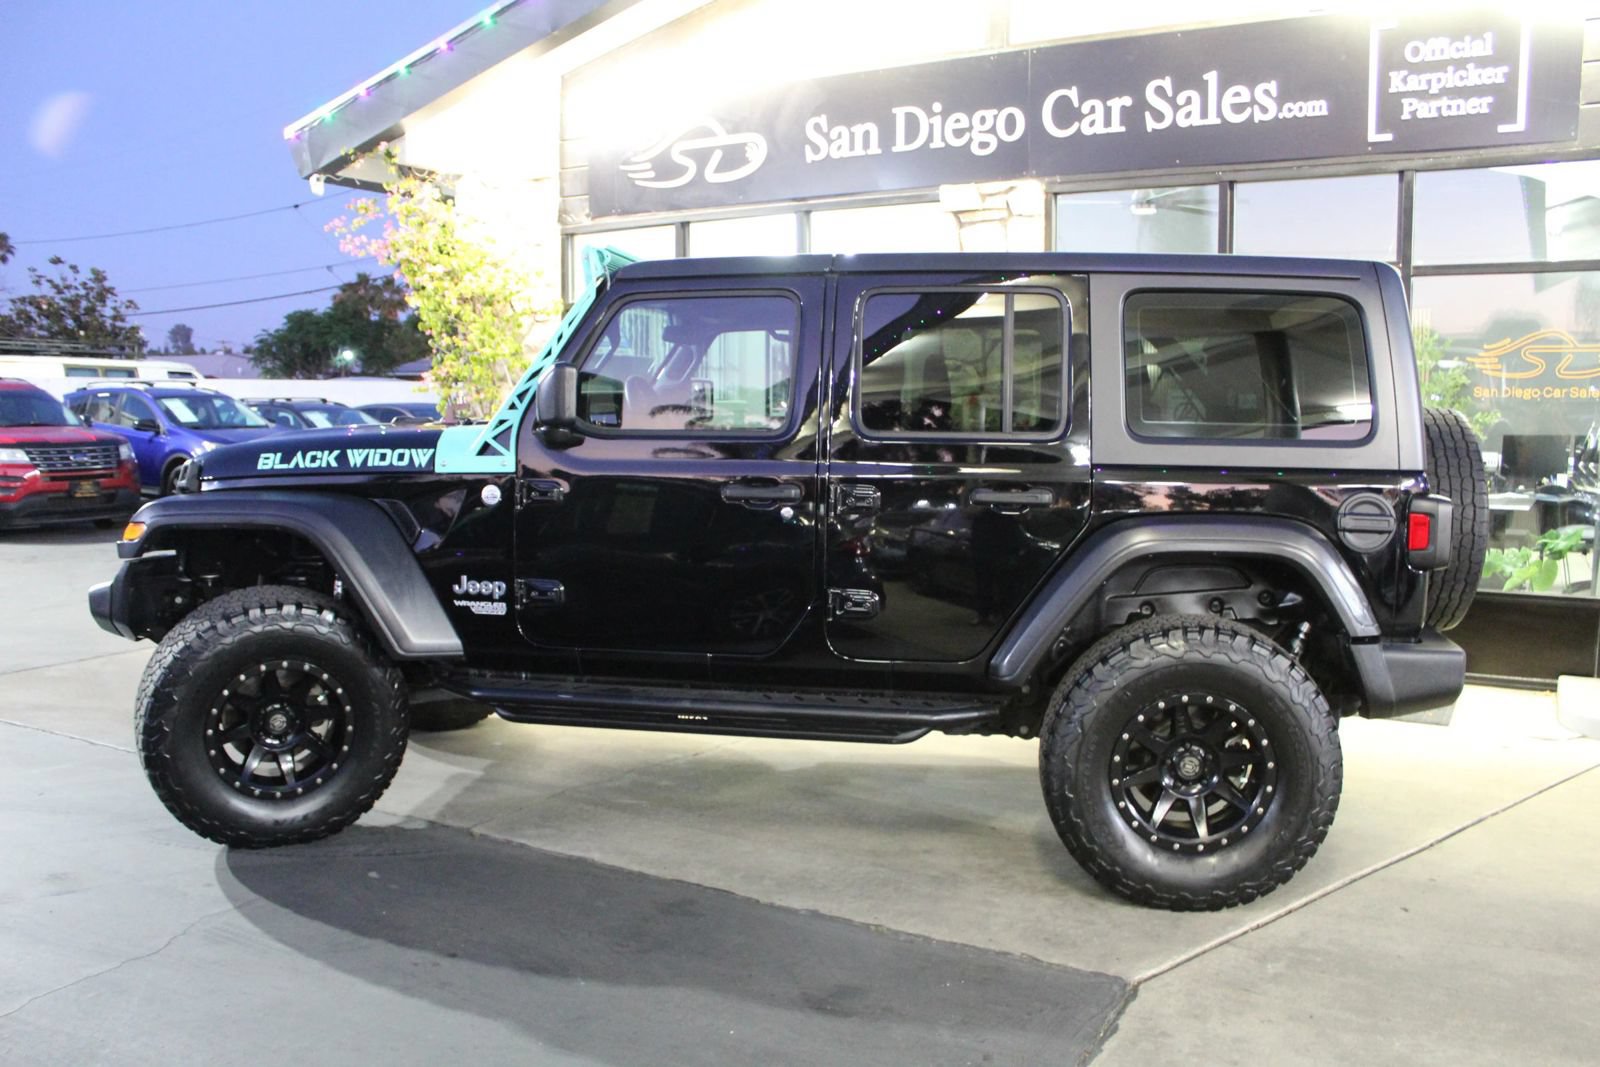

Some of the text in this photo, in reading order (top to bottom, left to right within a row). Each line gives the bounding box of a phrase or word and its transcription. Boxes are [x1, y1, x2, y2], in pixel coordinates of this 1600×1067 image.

[1404, 32, 1494, 63] Official
[1388, 63, 1510, 94] Karpicker
[1401, 96, 1494, 120] Partner
[804, 114, 882, 163] San
[891, 102, 1026, 156] Diego
[1042, 86, 1133, 138] Car
[1473, 386, 1498, 398] San
[1502, 386, 1541, 400] Diego
[1543, 386, 1568, 398] Car
[257, 448, 435, 470] BLACK WIDOW
[452, 575, 506, 600] Jeep
